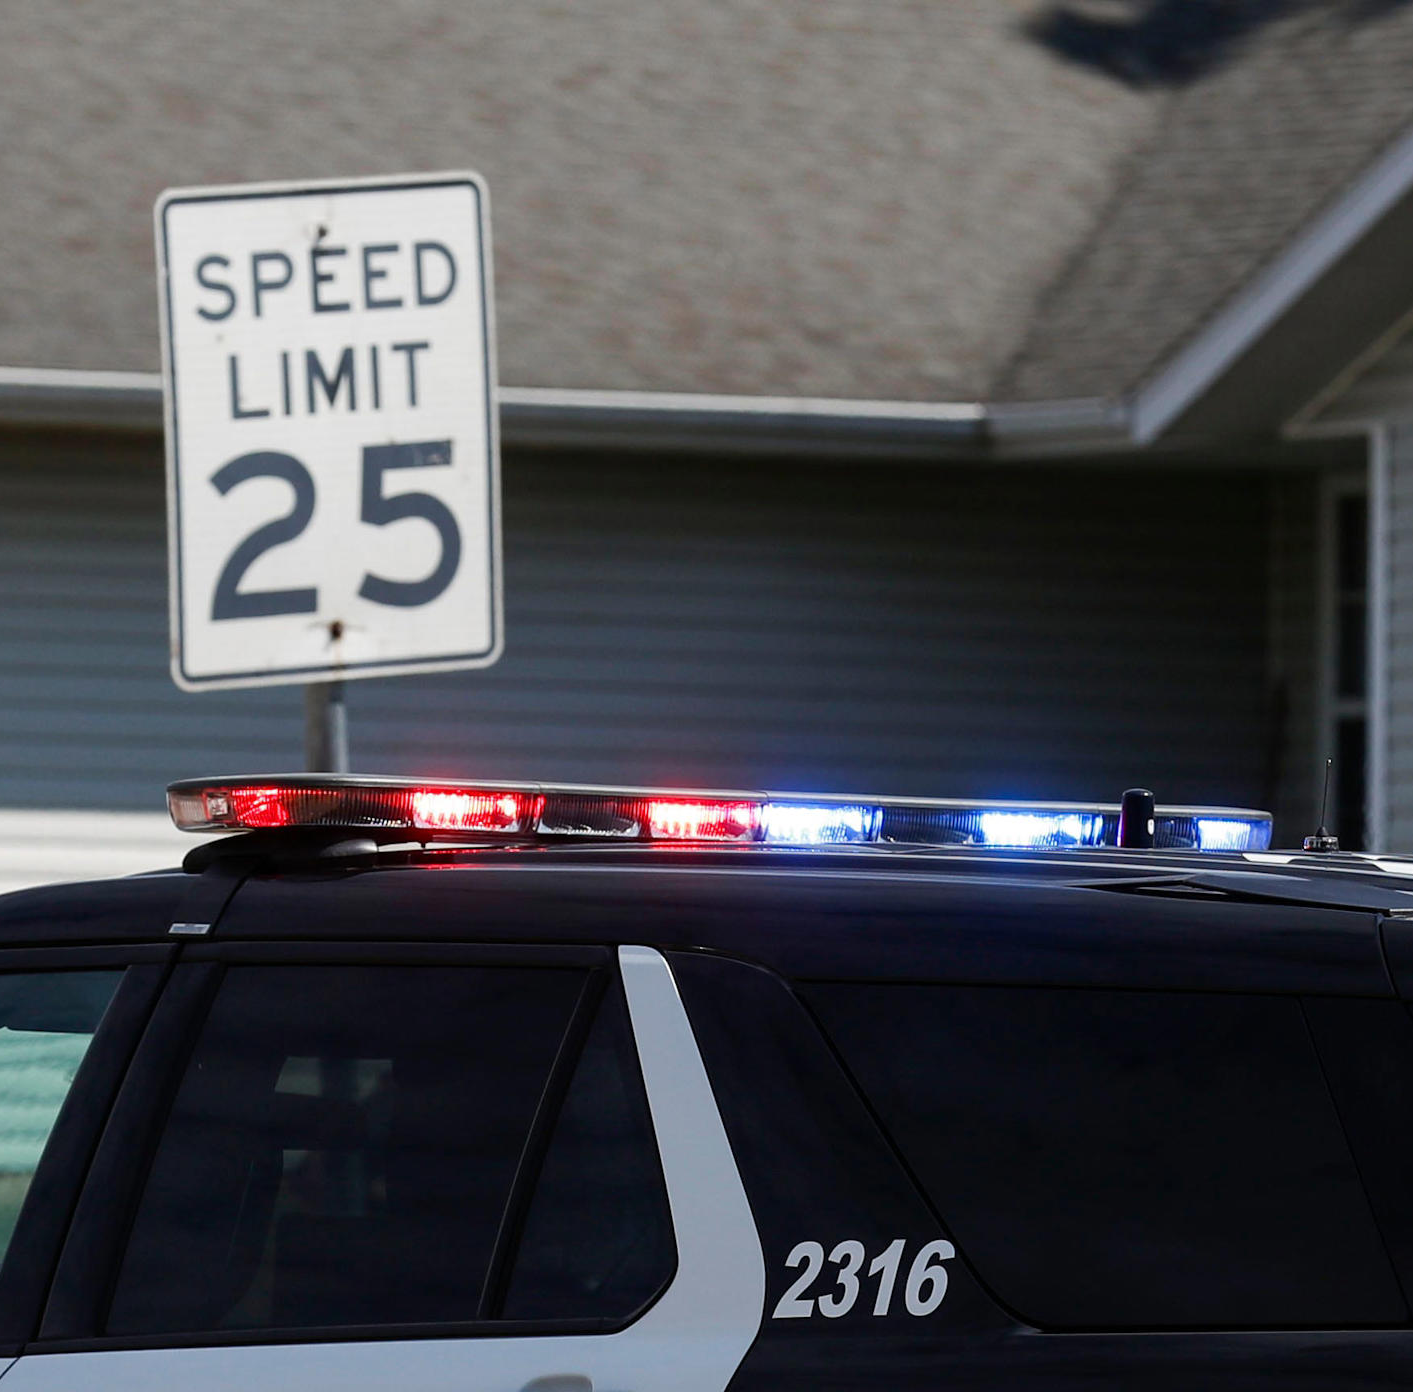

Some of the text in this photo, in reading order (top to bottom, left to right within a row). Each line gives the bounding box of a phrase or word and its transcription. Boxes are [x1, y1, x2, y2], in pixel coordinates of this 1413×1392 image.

[196, 241, 458, 322] SPEED
[229, 341, 430, 420] LIMIT
[209, 439, 462, 621] 25
[772, 1239, 956, 1318] 2316
